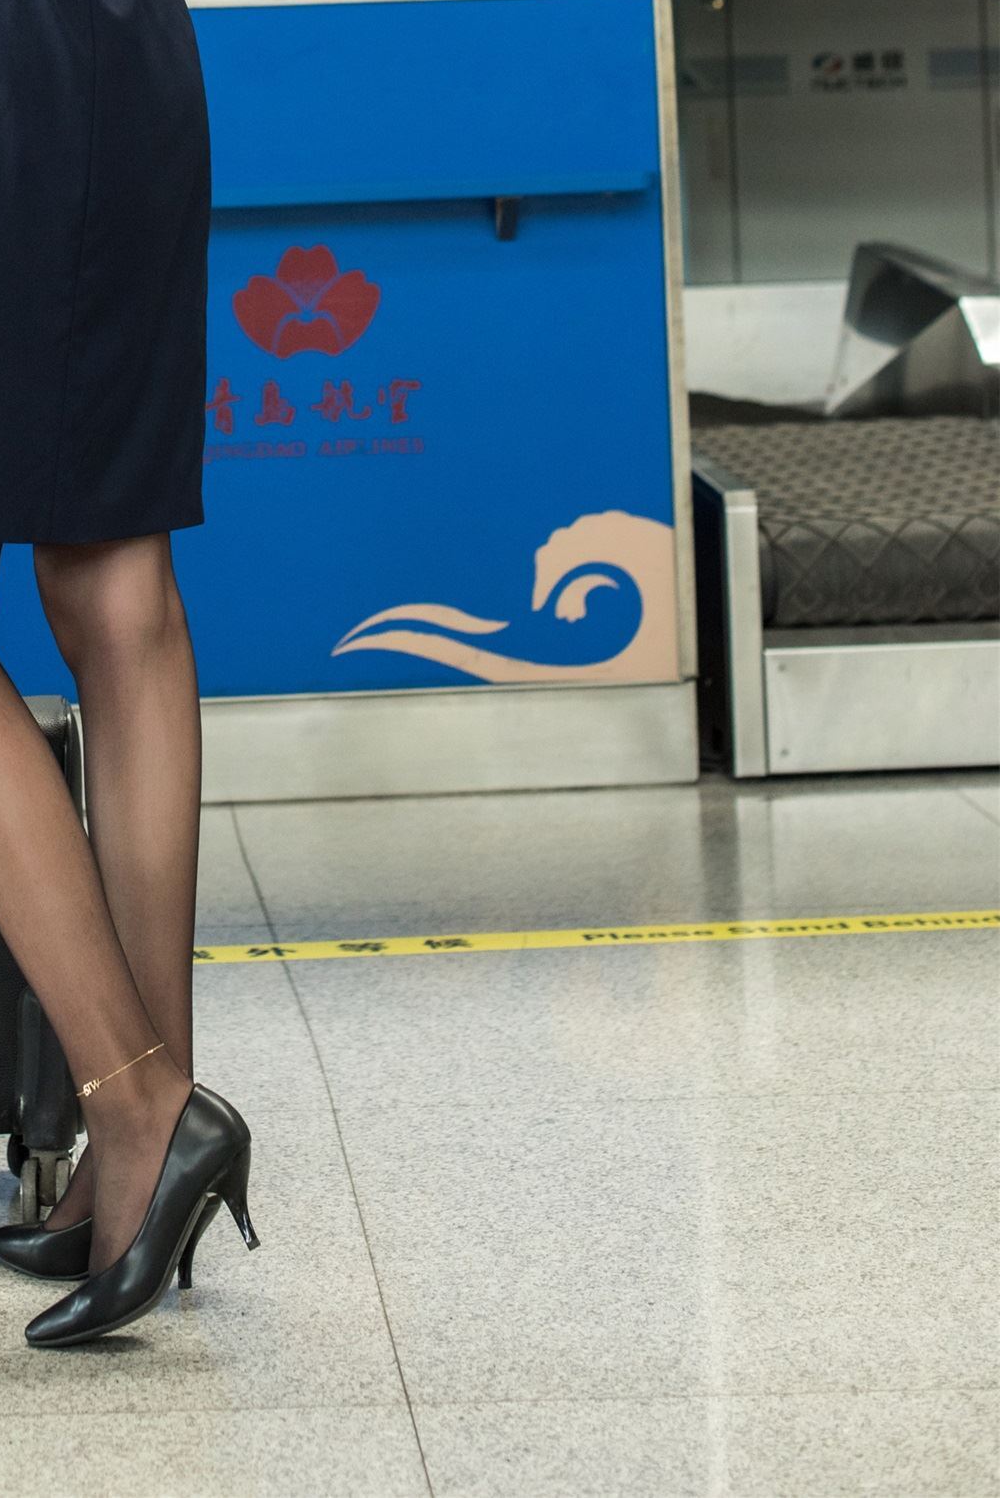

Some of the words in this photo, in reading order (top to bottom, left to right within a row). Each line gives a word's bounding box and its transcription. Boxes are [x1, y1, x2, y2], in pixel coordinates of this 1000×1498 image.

[204, 377, 423, 436] 青岛航空
[581, 929, 714, 942] Please
[727, 921, 850, 936] Stand
